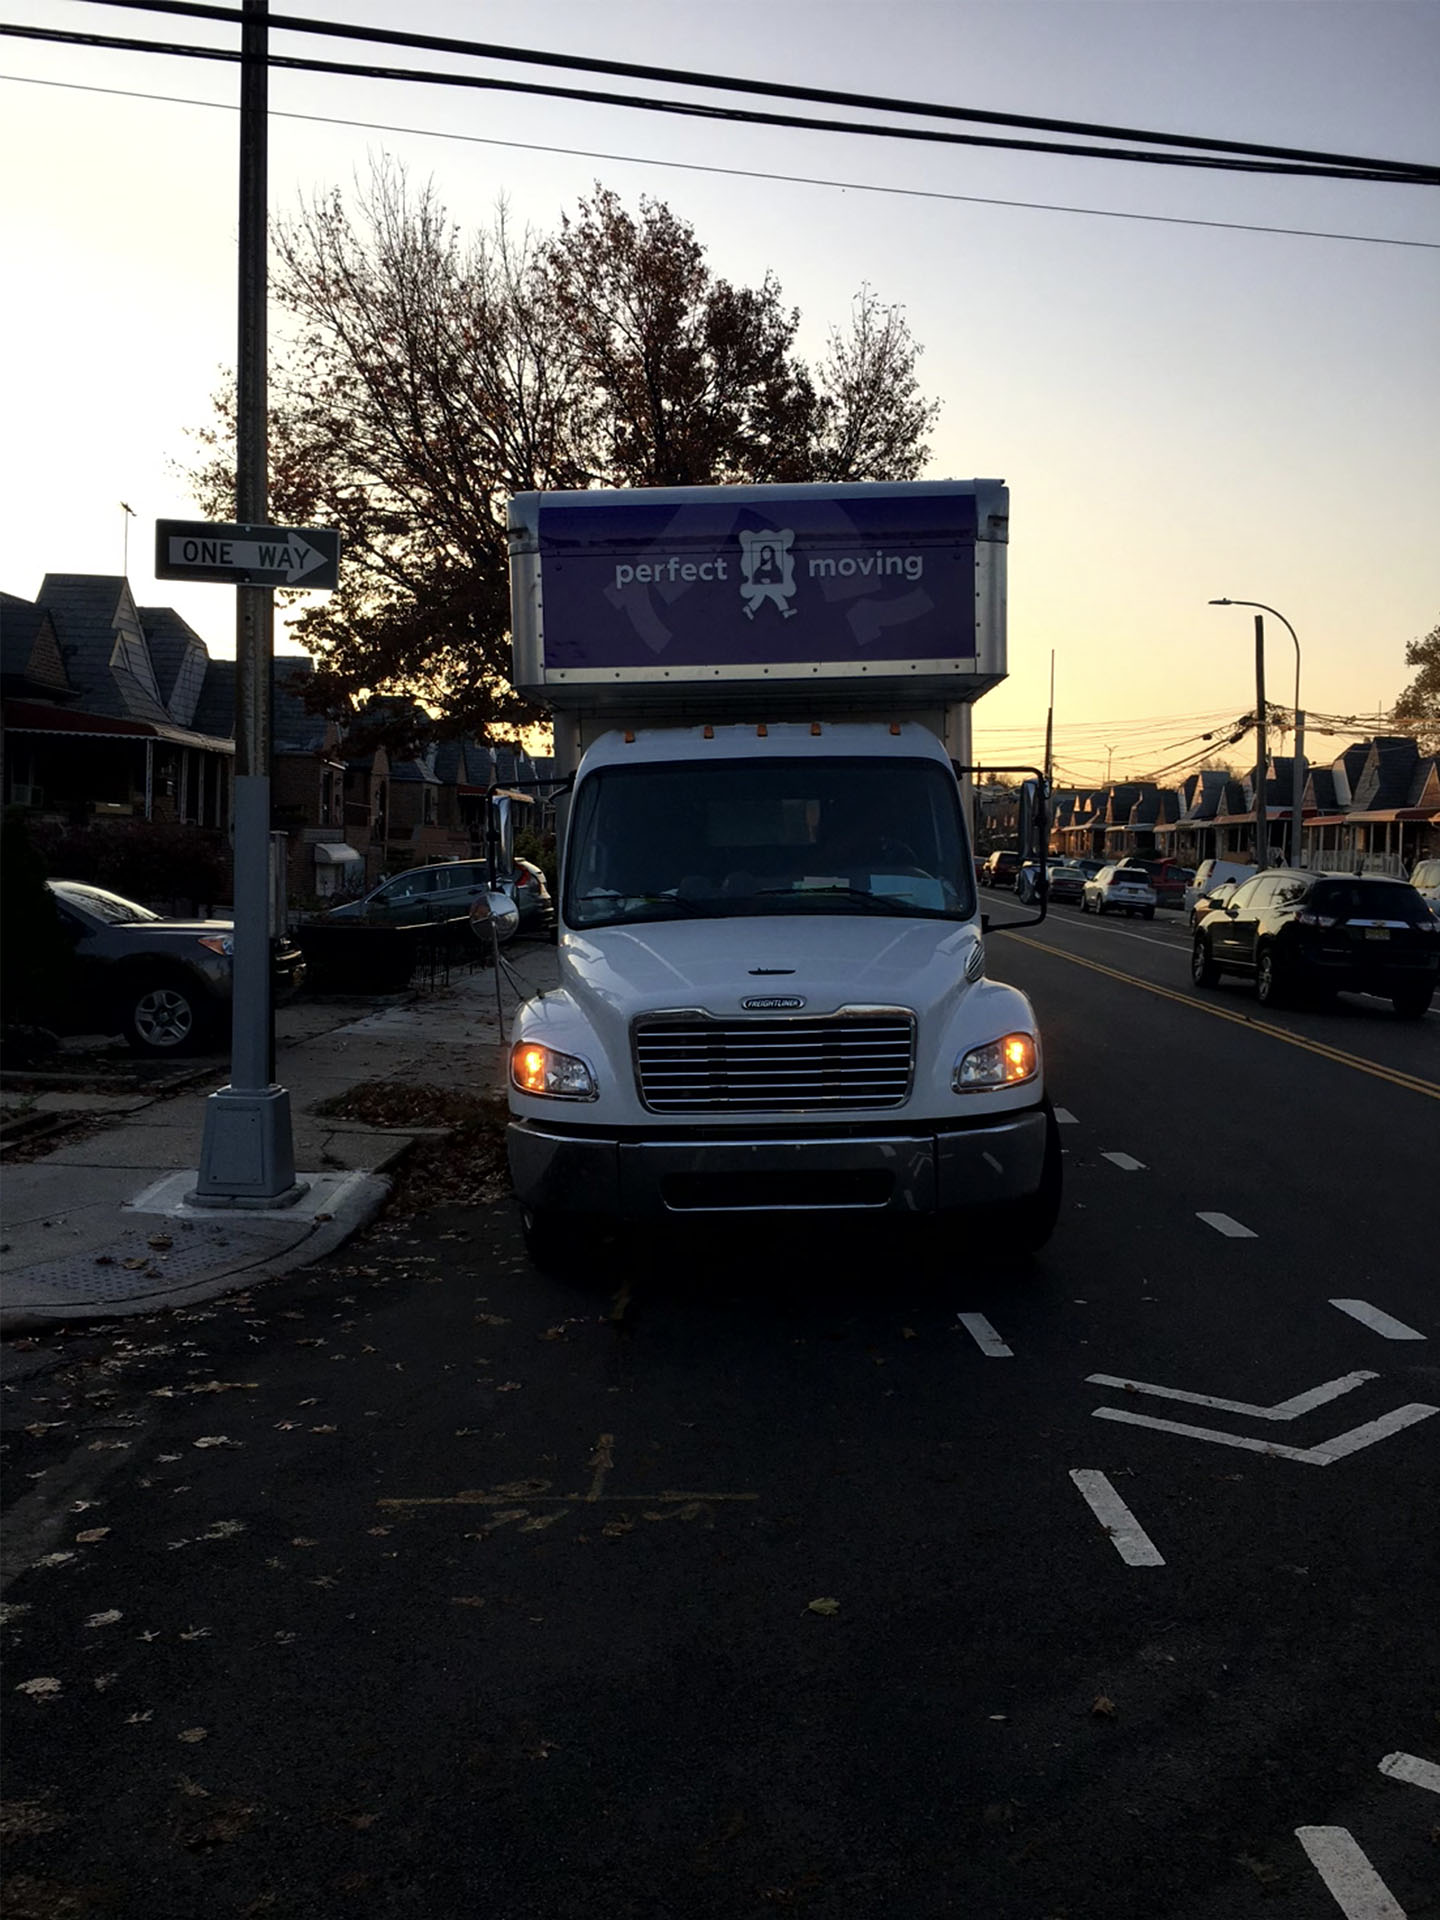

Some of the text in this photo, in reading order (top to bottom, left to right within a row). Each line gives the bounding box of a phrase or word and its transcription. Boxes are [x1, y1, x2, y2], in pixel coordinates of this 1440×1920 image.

[183, 540, 310, 569] ONE WAY
[615, 550, 924, 589] perfect moving
[747, 999, 799, 1008] FREIGHTLINER
